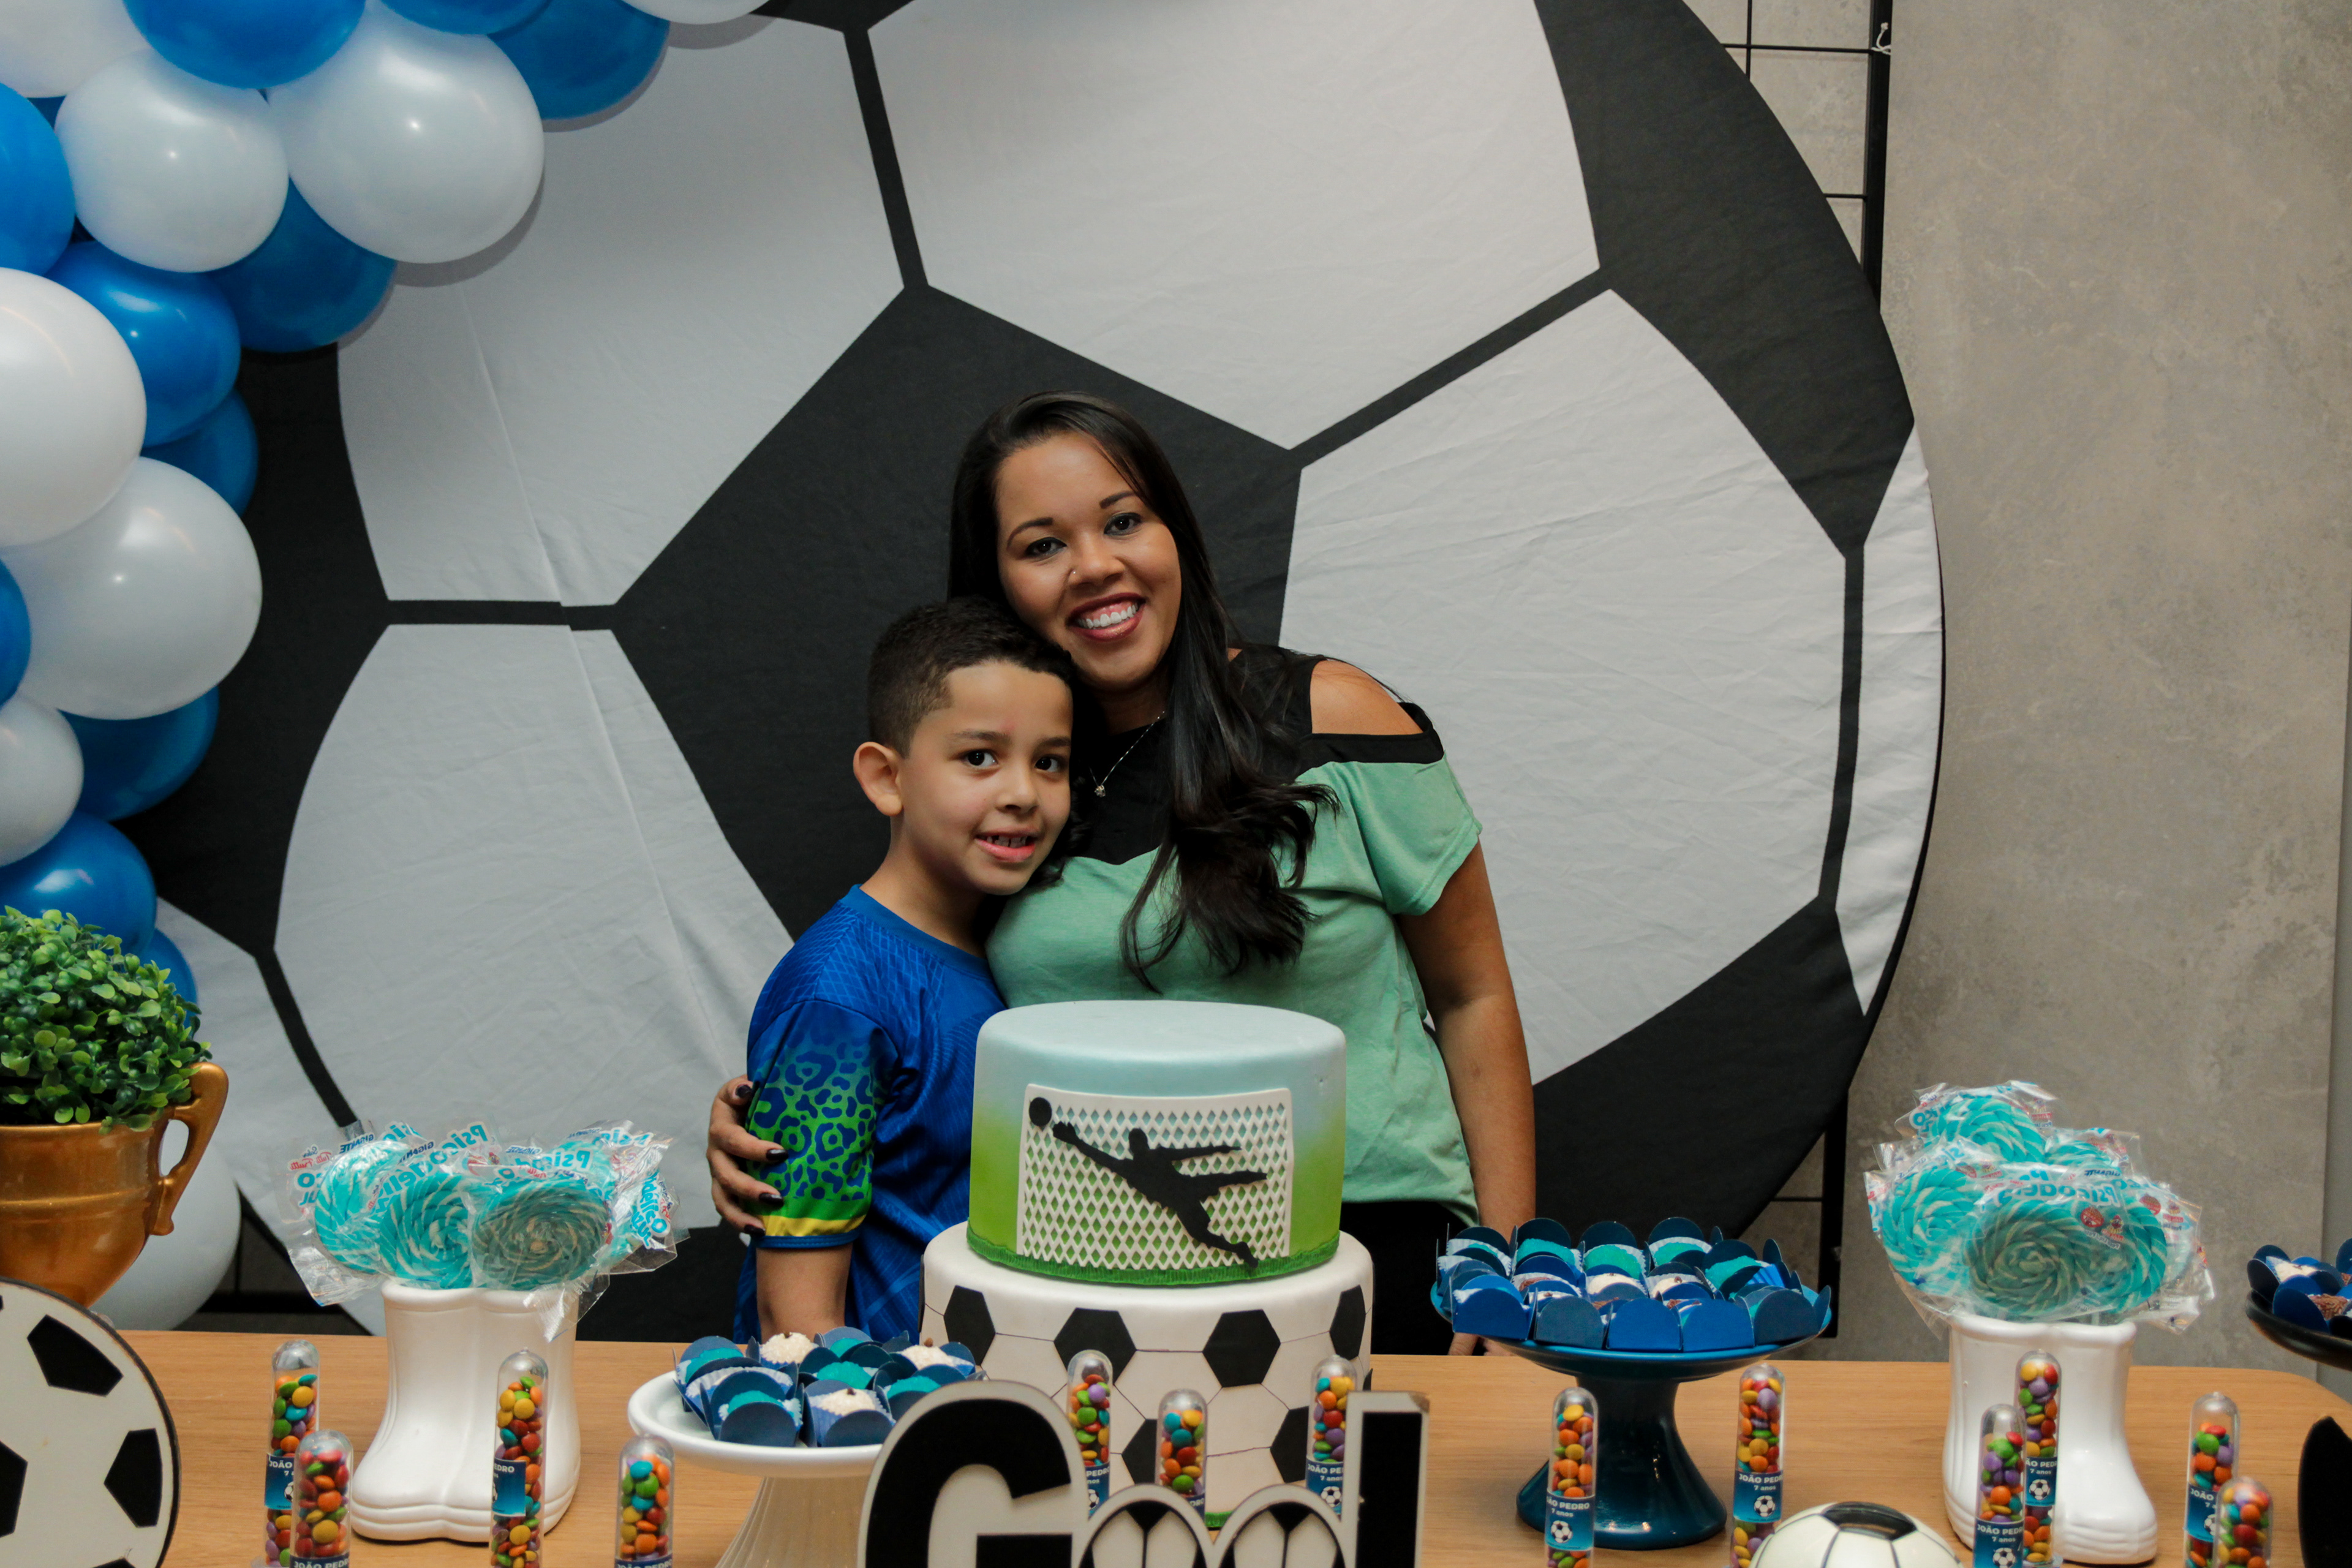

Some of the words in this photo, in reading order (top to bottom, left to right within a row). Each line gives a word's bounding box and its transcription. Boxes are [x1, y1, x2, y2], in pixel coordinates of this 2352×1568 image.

[269, 1460, 292, 1469] JOÃO
[1308, 1464, 1328, 1474] JOÃO
[1739, 1473, 1762, 1483] JOÃO
[2191, 1488, 2214, 1501] JOÃO
[1977, 1524, 2000, 1535] JOÃO
